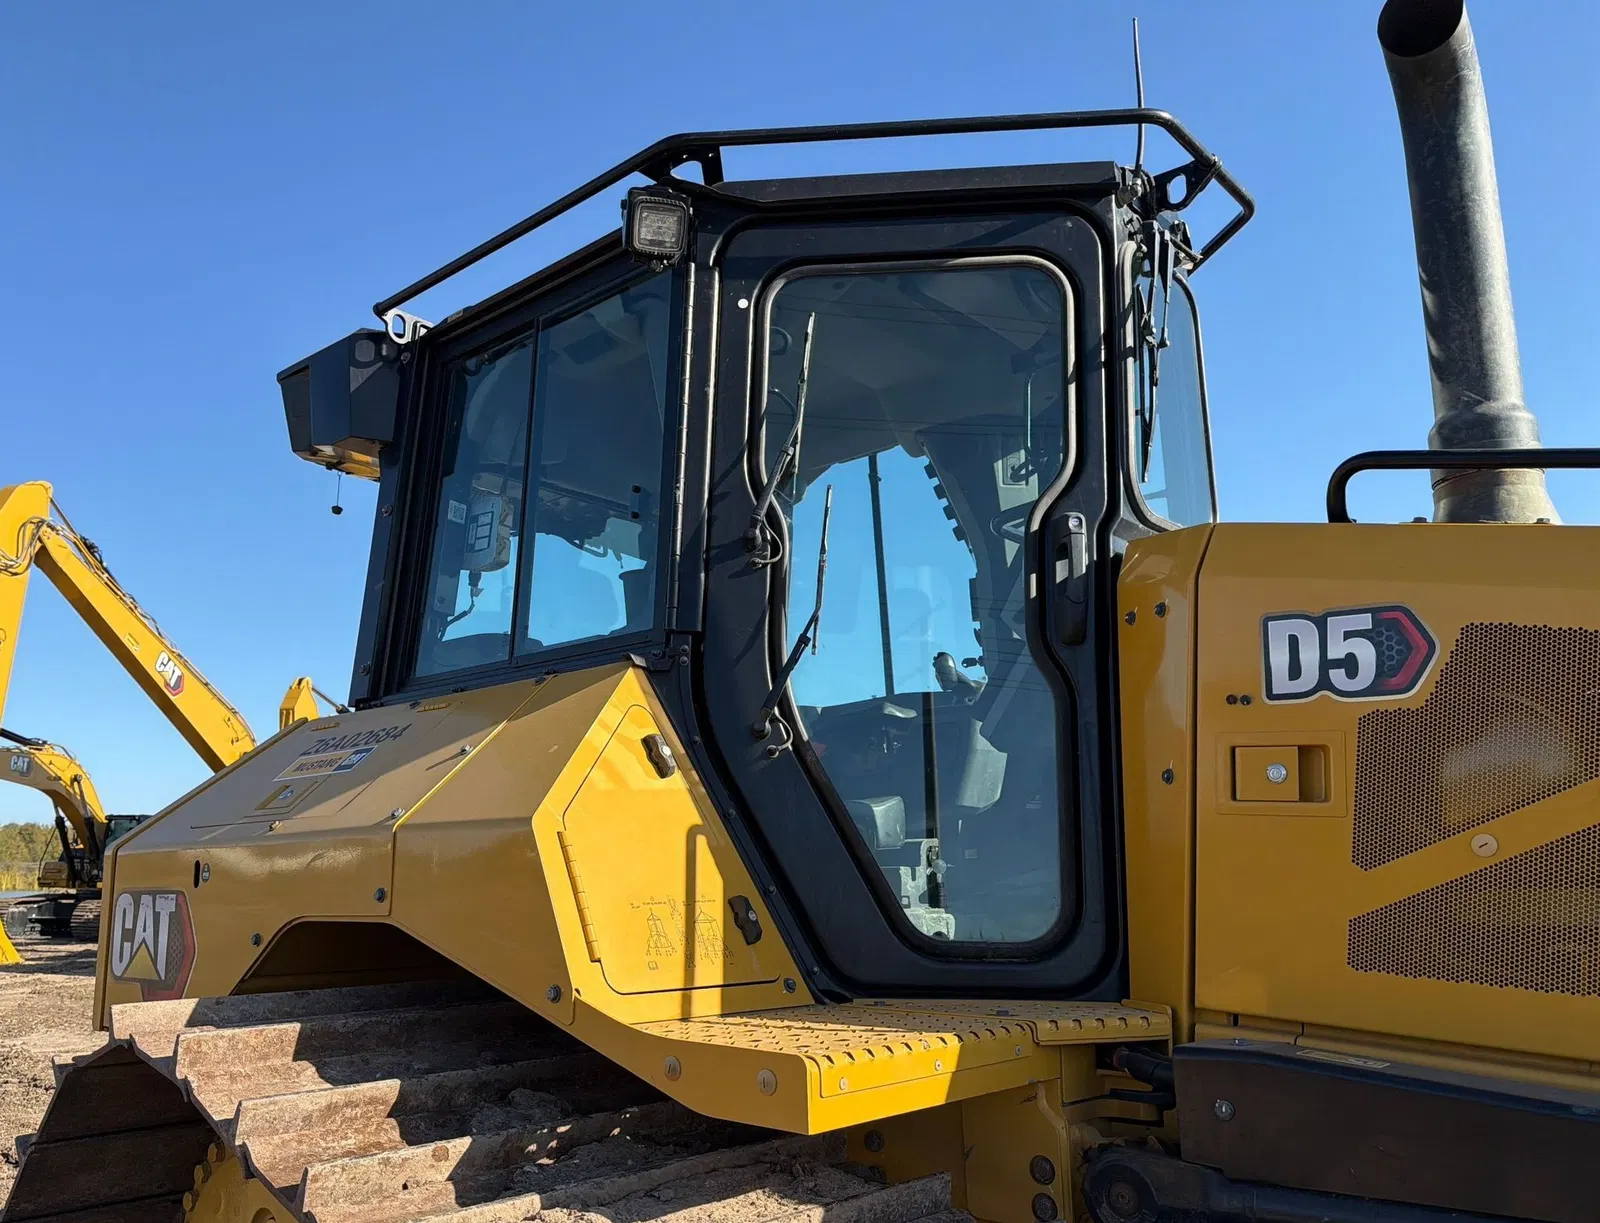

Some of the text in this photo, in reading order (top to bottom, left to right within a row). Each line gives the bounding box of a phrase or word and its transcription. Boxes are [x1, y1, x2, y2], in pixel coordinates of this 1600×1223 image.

[155, 651, 182, 688] CAT
[1268, 613, 1377, 694] D5
[11, 755, 29, 773] CAT
[292, 752, 366, 772] MUSTANG CAT
[112, 893, 176, 980] CAT
